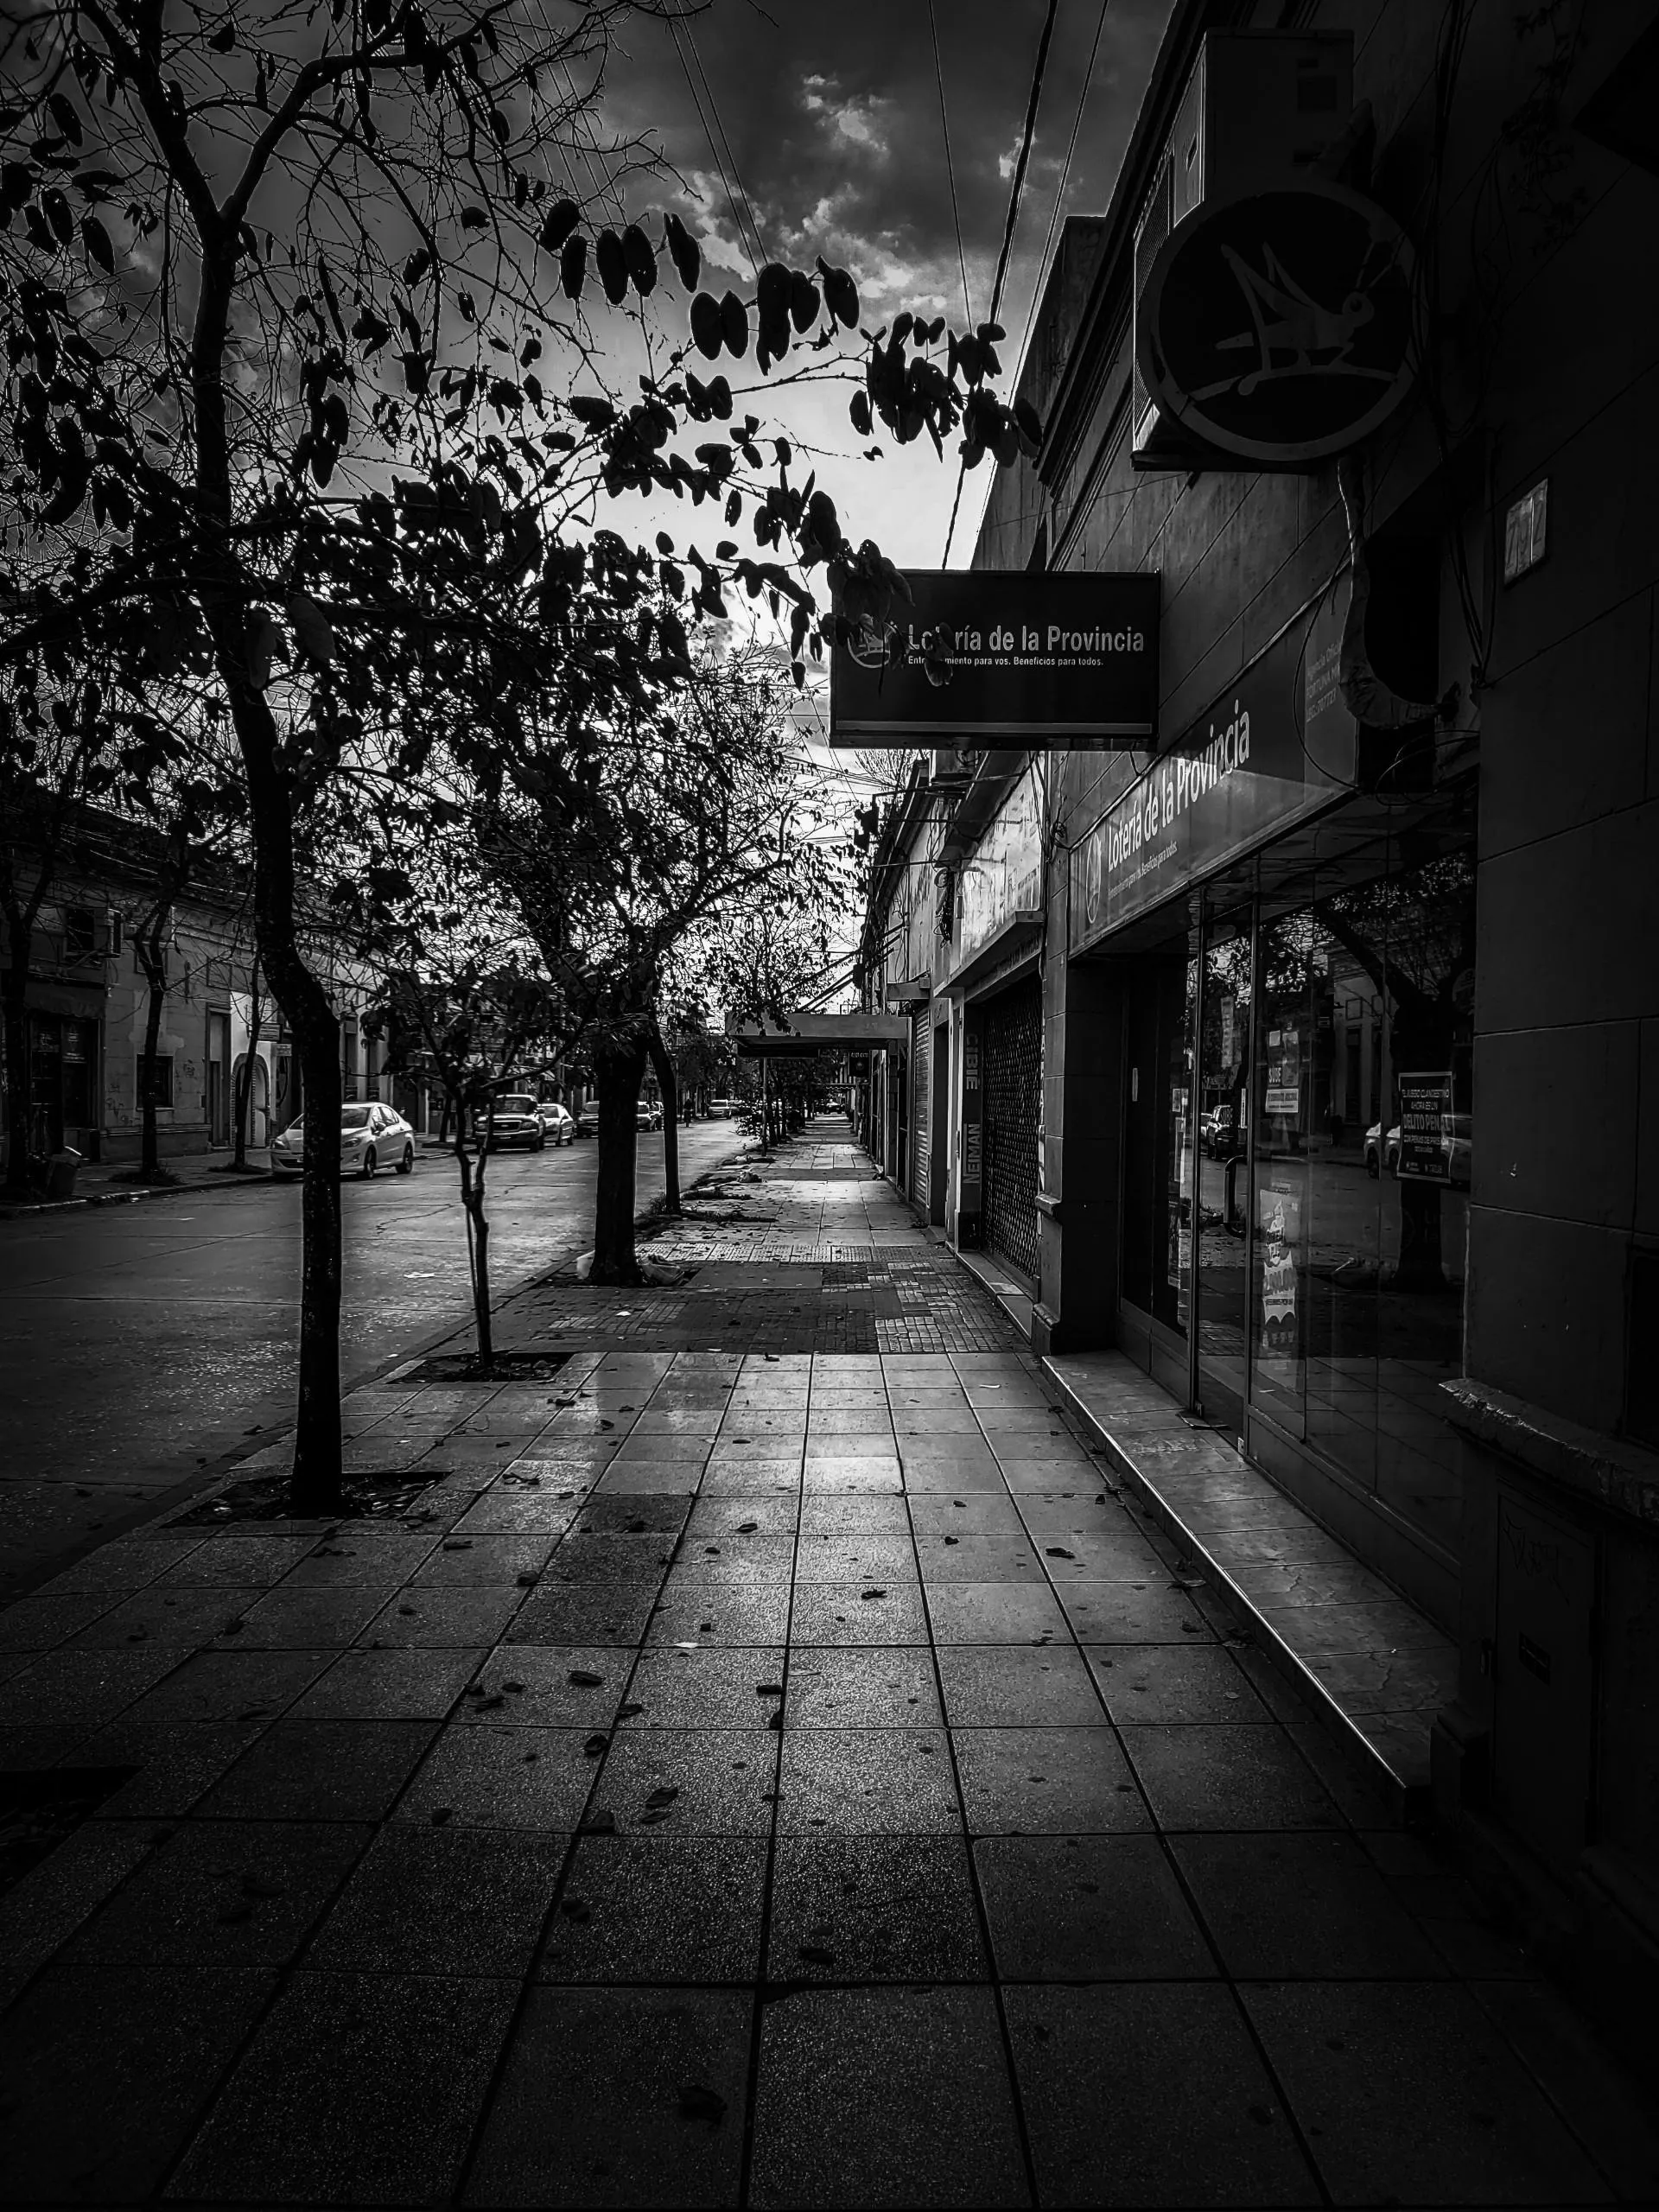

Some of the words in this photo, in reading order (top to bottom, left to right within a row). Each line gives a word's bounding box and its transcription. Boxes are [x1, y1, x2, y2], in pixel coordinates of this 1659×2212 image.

[908, 624, 982, 651] Loría
[988, 625, 1014, 651] de
[1021, 625, 1039, 651] la
[1047, 625, 1144, 652] Provincia
[974, 658, 992, 667] para
[1014, 656, 1055, 665] Beneficios
[1058, 658, 1076, 667] para
[1109, 800, 1141, 873] Lotería
[1144, 783, 1159, 842] de
[1162, 769, 1173, 828] la
[1177, 699, 1249, 816] Provincia
[963, 1123, 982, 1184] NEIMAN
